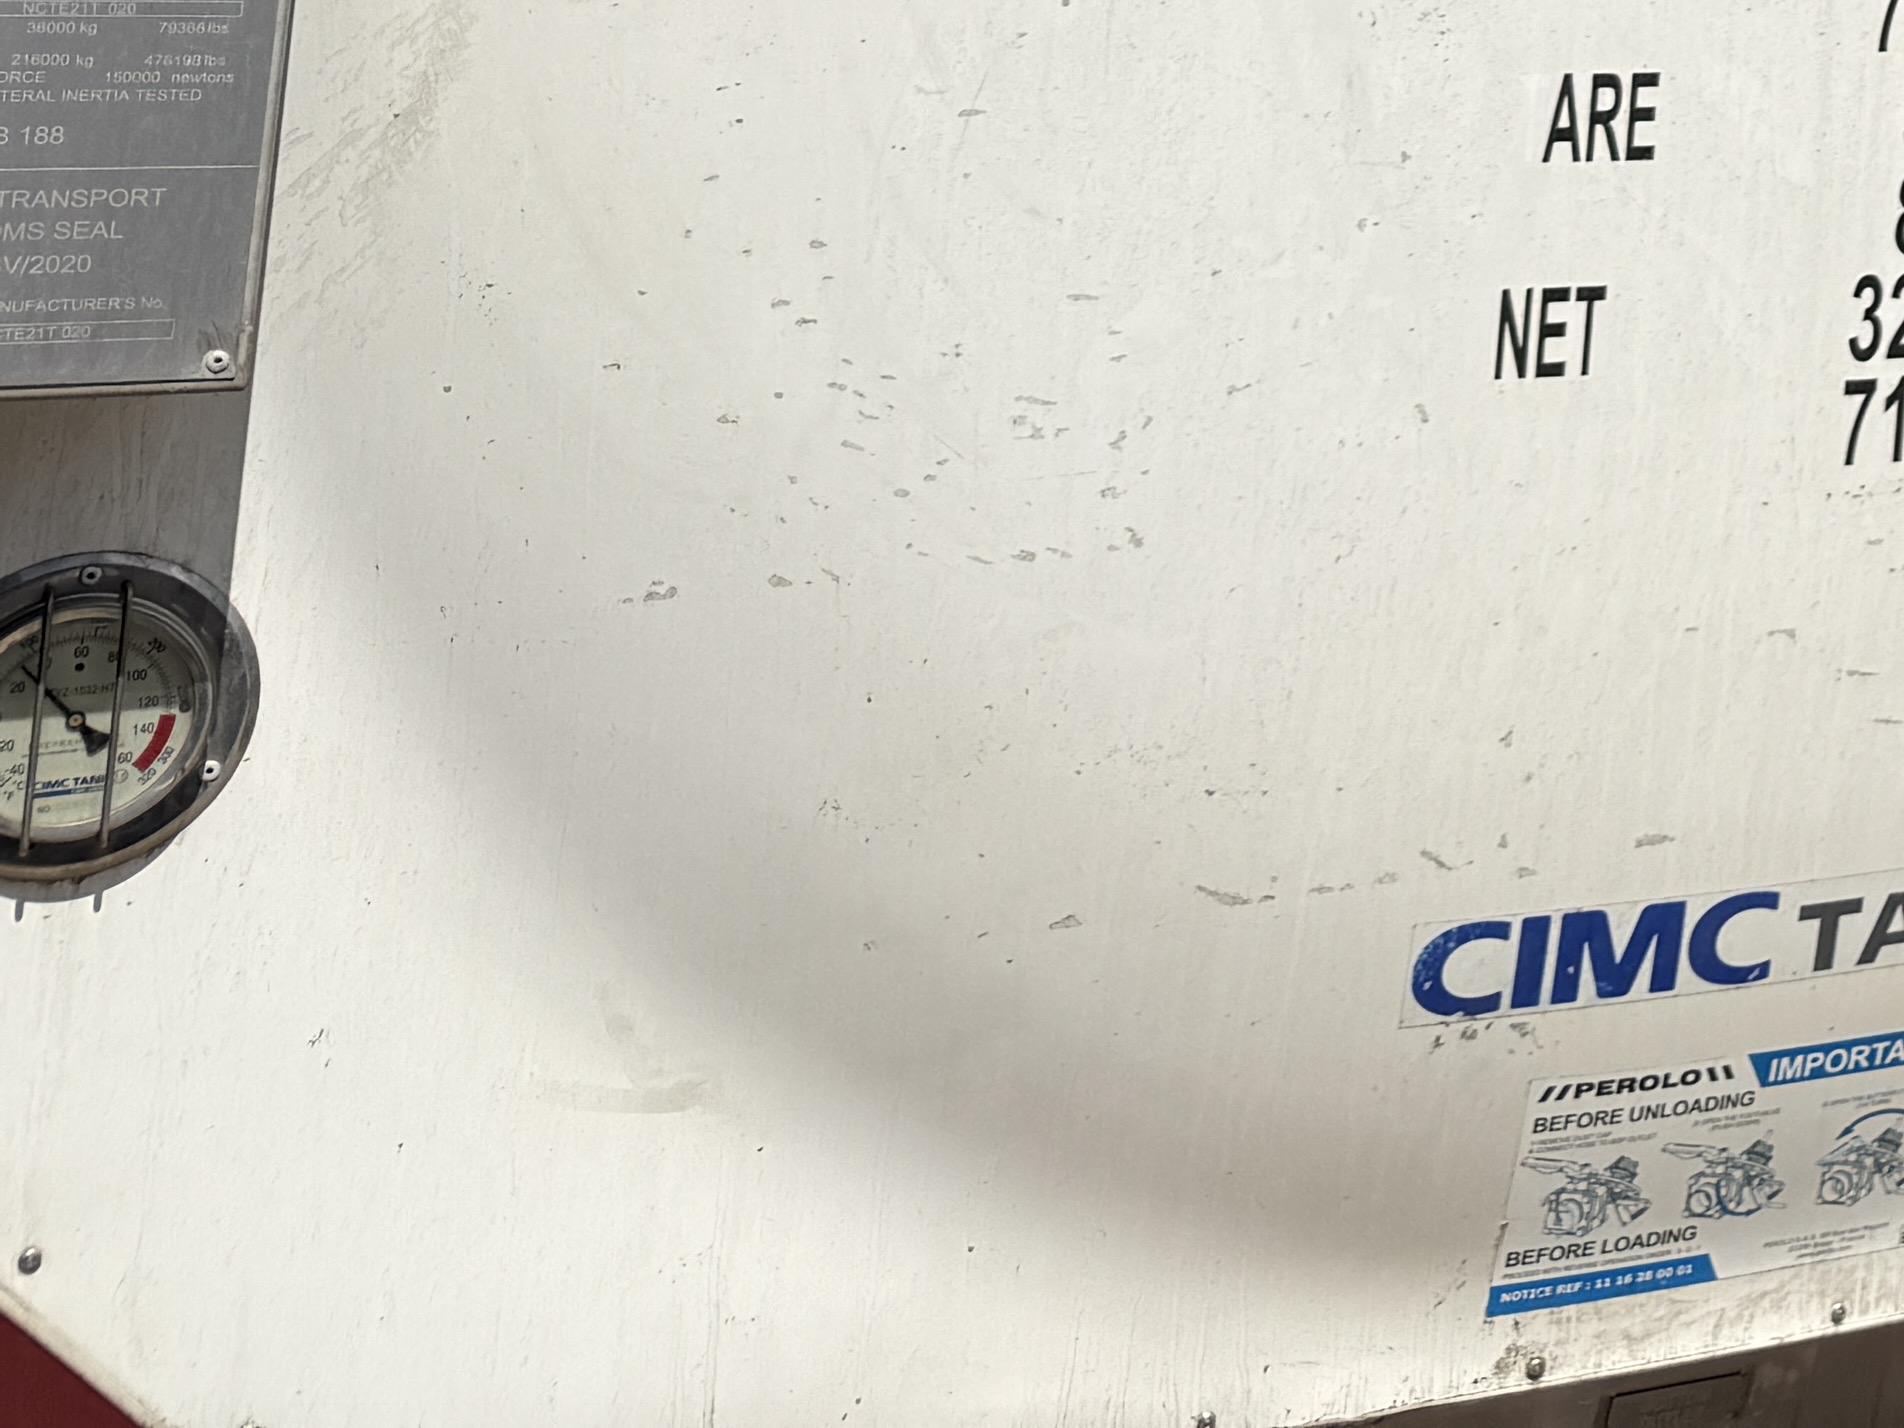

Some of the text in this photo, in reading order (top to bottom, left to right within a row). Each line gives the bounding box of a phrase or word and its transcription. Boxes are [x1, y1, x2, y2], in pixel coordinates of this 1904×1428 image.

[108, 3, 137, 15] 020
[79, 23, 97, 36] kg
[76, 55, 94, 68] kg
[171, 73, 234, 84] newtons
[61, 89, 129, 101] INERTIA
[136, 89, 202, 101] TESTED
[20, 126, 64, 145] 188
[0, 188, 167, 208] TRANSPORT
[53, 220, 124, 240] SEAL
[3, 255, 91, 277] V/2020
[62, 326, 91, 338] 020
[1495, 284, 1607, 380] NET
[74, 646, 89, 658] 60
[127, 670, 147, 681] 100
[10, 682, 25, 694] 20
[138, 695, 159, 707] 120
[133, 722, 154, 736] 140
[1410, 890, 1781, 1016] CIMC
[1532, 1107, 1624, 1135] BEFORE
[1628, 1090, 1756, 1123] UNLOADING
[1505, 1240, 1597, 1268] BEFORE
[1601, 1225, 1698, 1255] LOADING
[1501, 1287, 1553, 1303] NOTICE
